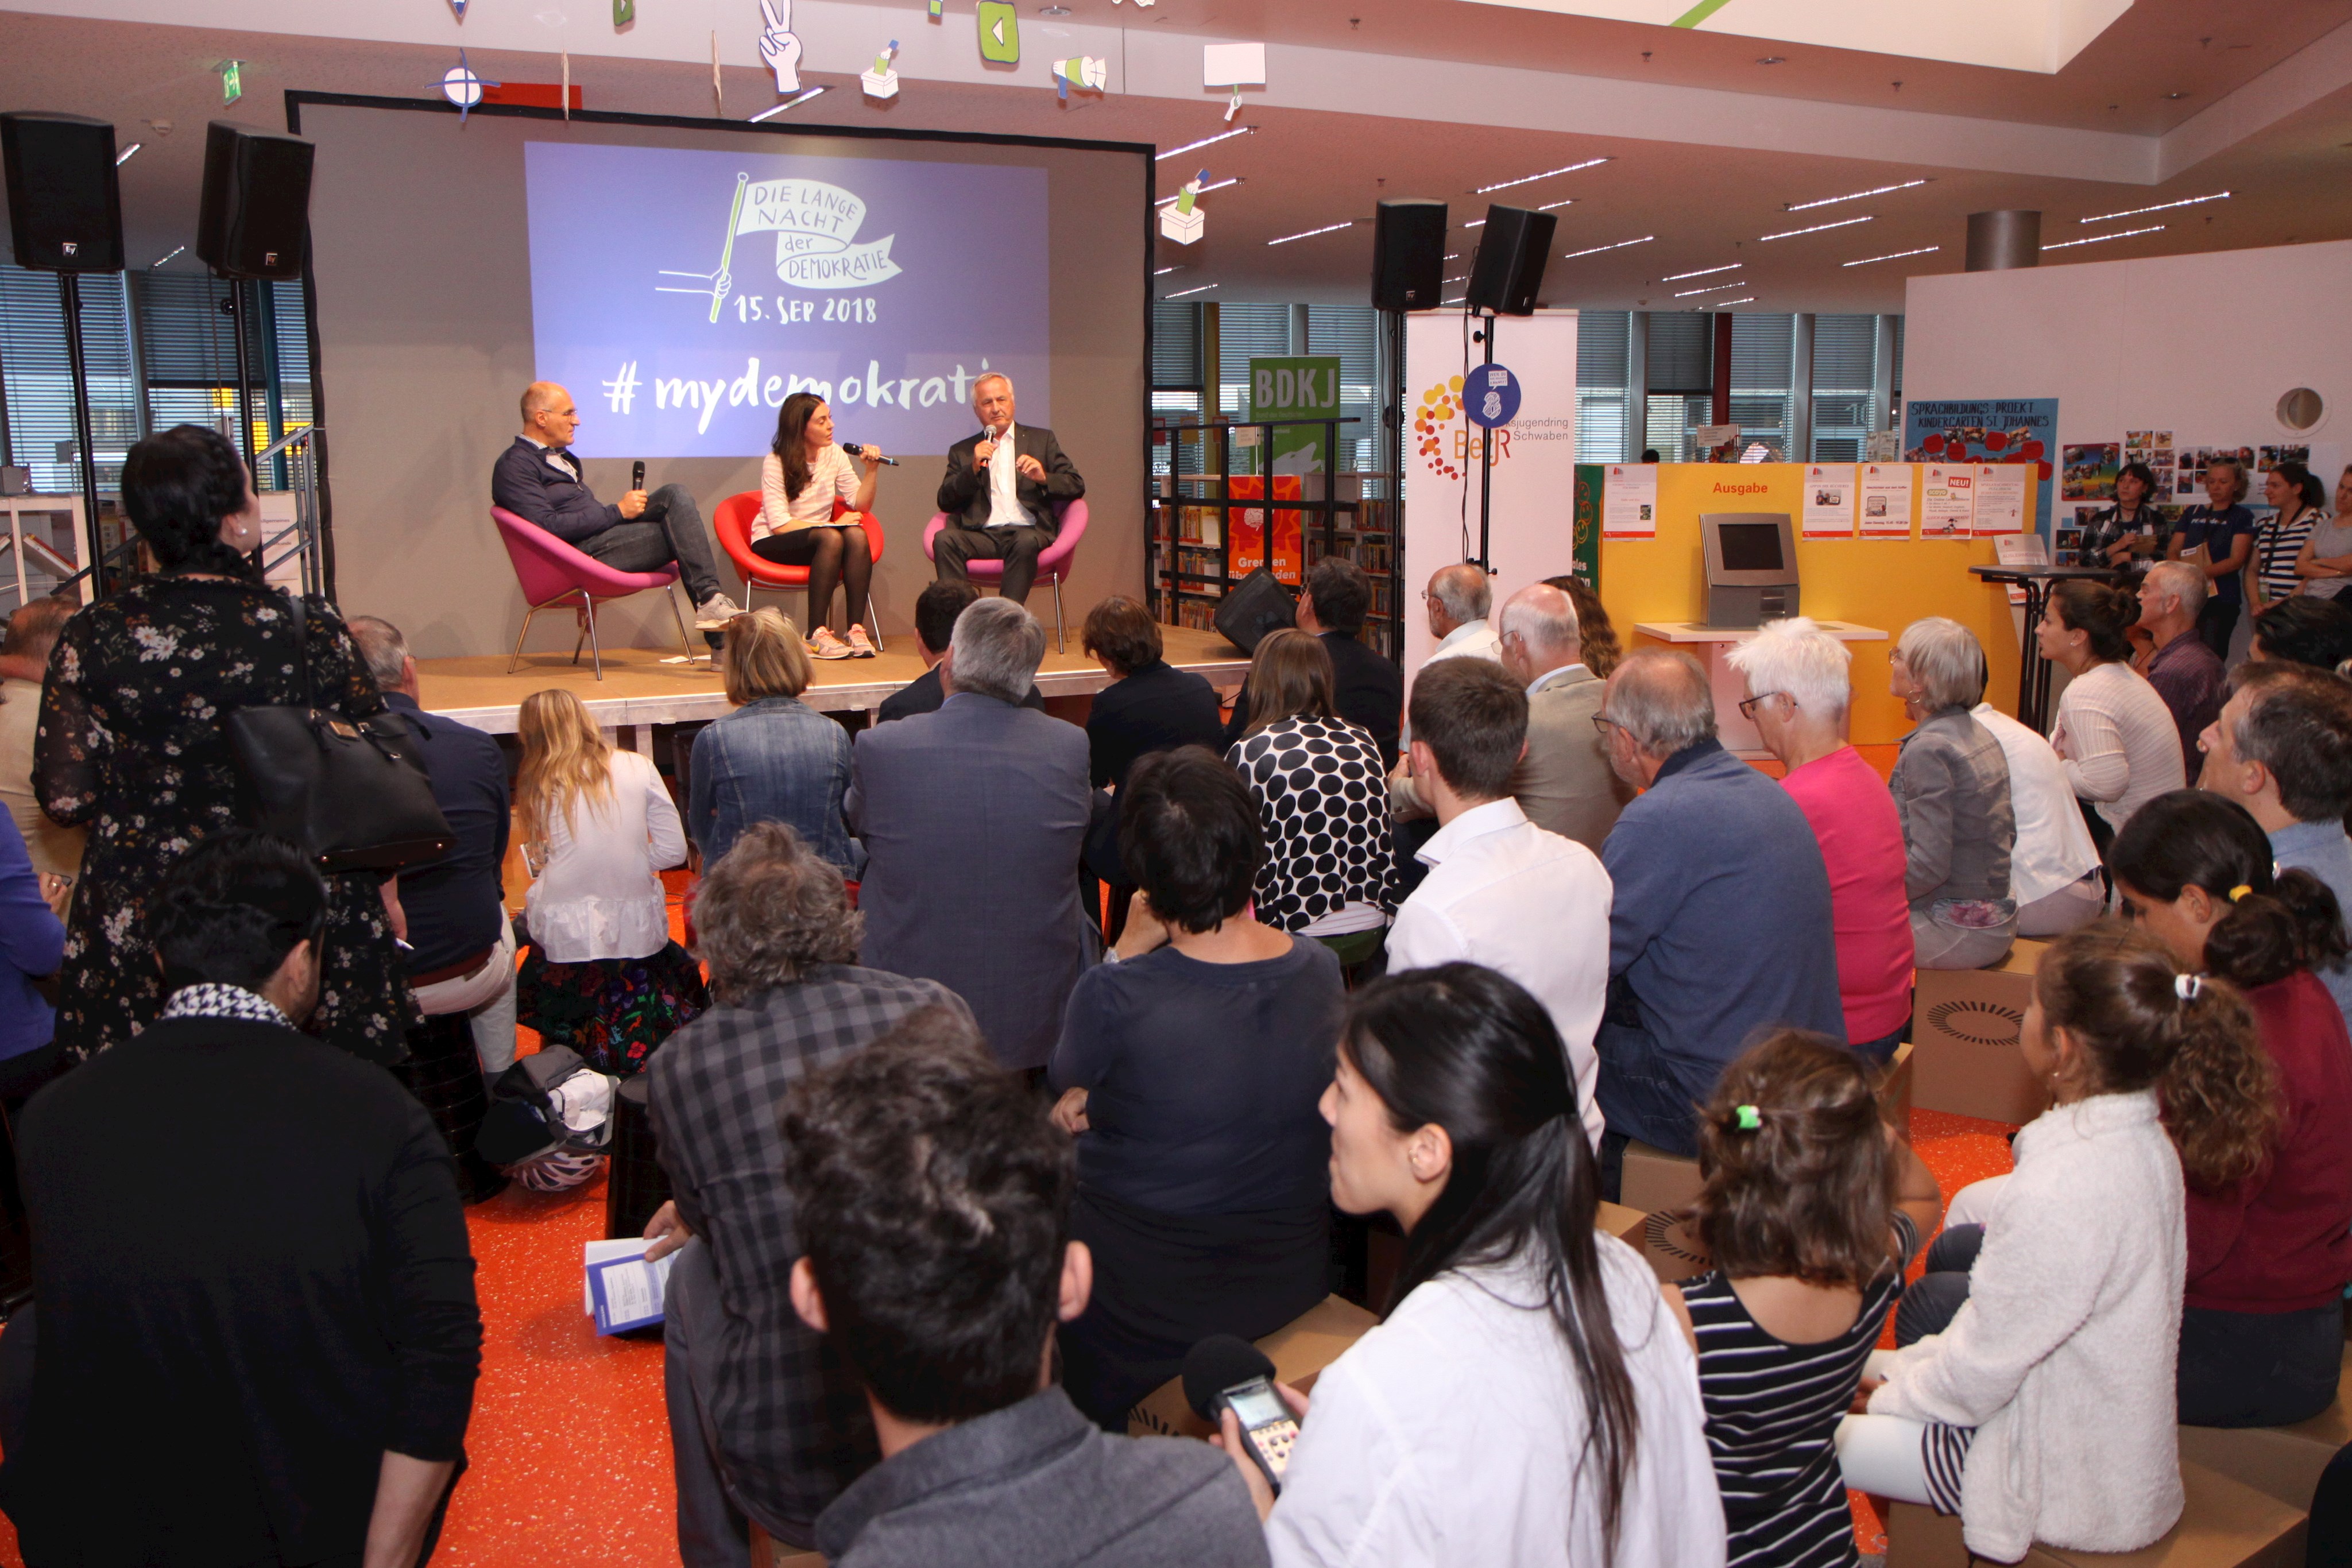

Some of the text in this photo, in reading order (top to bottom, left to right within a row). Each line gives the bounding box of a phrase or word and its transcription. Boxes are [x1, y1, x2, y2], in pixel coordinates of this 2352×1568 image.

[755, 185, 858, 220] DIE LANGE
[759, 208, 844, 233] NACHT
[784, 235, 814, 252] der
[789, 250, 888, 280] DEMOKRATIE
[734, 295, 877, 325] 15. SEP 2018
[602, 357, 989, 435] #mydemokrat
[1255, 369, 1335, 408] BDKJ
[1513, 431, 1568, 440] Schwaben
[1999, 415, 2049, 431] JOHANNES
[1713, 482, 1768, 495] Ausgabe
[1949, 479, 1969, 487] NEU!
